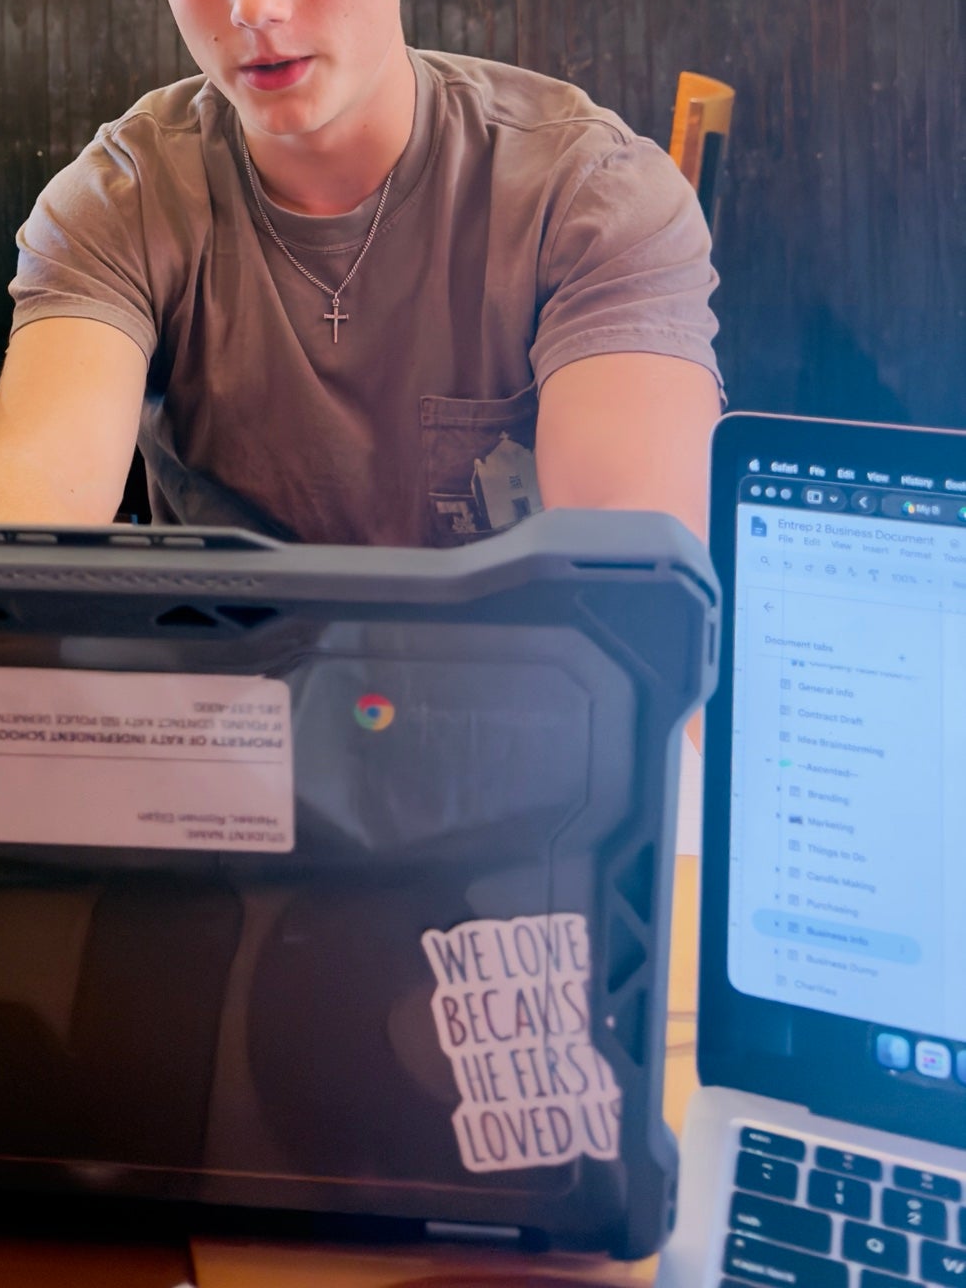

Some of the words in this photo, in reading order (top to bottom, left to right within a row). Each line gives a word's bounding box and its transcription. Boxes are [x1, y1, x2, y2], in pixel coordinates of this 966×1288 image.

[770, 460, 799, 475] Safari
[809, 465, 826, 478] File
[837, 468, 856, 481] Edit
[867, 471, 891, 484] View
[901, 475, 934, 489] History
[778, 518, 813, 534] Entrep
[816, 523, 822, 533] 2
[825, 524, 873, 539] Business
[875, 529, 935, 546] Document
[778, 535, 794, 544] File
[804, 537, 821, 546] Edit
[831, 540, 852, 551] View
[862, 543, 889, 555] Insert
[899, 548, 932, 560] Format
[764, 635, 811, 650] Document
[813, 643, 834, 653] tabs
[798, 682, 834, 696] General
[835, 688, 854, 699] info
[797, 708, 838, 723] Contract
[840, 715, 864, 727] Draft
[50, 730, 146, 745] INDEPENDENT
[150, 733, 184, 746] KATY
[189, 735, 207, 747] OF
[211, 735, 282, 749] PROPERTY
[797, 735, 817, 747] Idea
[819, 738, 885, 759] Brainstorming
[808, 790, 850, 807] Branding
[808, 817, 855, 835] Marketing
[808, 843, 839, 859] Things
[806, 871, 840, 886] Candle
[841, 878, 876, 894] Making
[806, 898, 860, 918] Purchasing
[806, 926, 848, 943] Business
[431, 930, 492, 984] WE
[495, 919, 585, 978] LOVE
[806, 954, 848, 971] Business
[442, 981, 588, 1047] BECAUS
[461, 1052, 506, 1103] HE
[509, 1043, 607, 1101] FIRST
[462, 1107, 574, 1163] LOVED
[865, 1237, 886, 1255] Q
